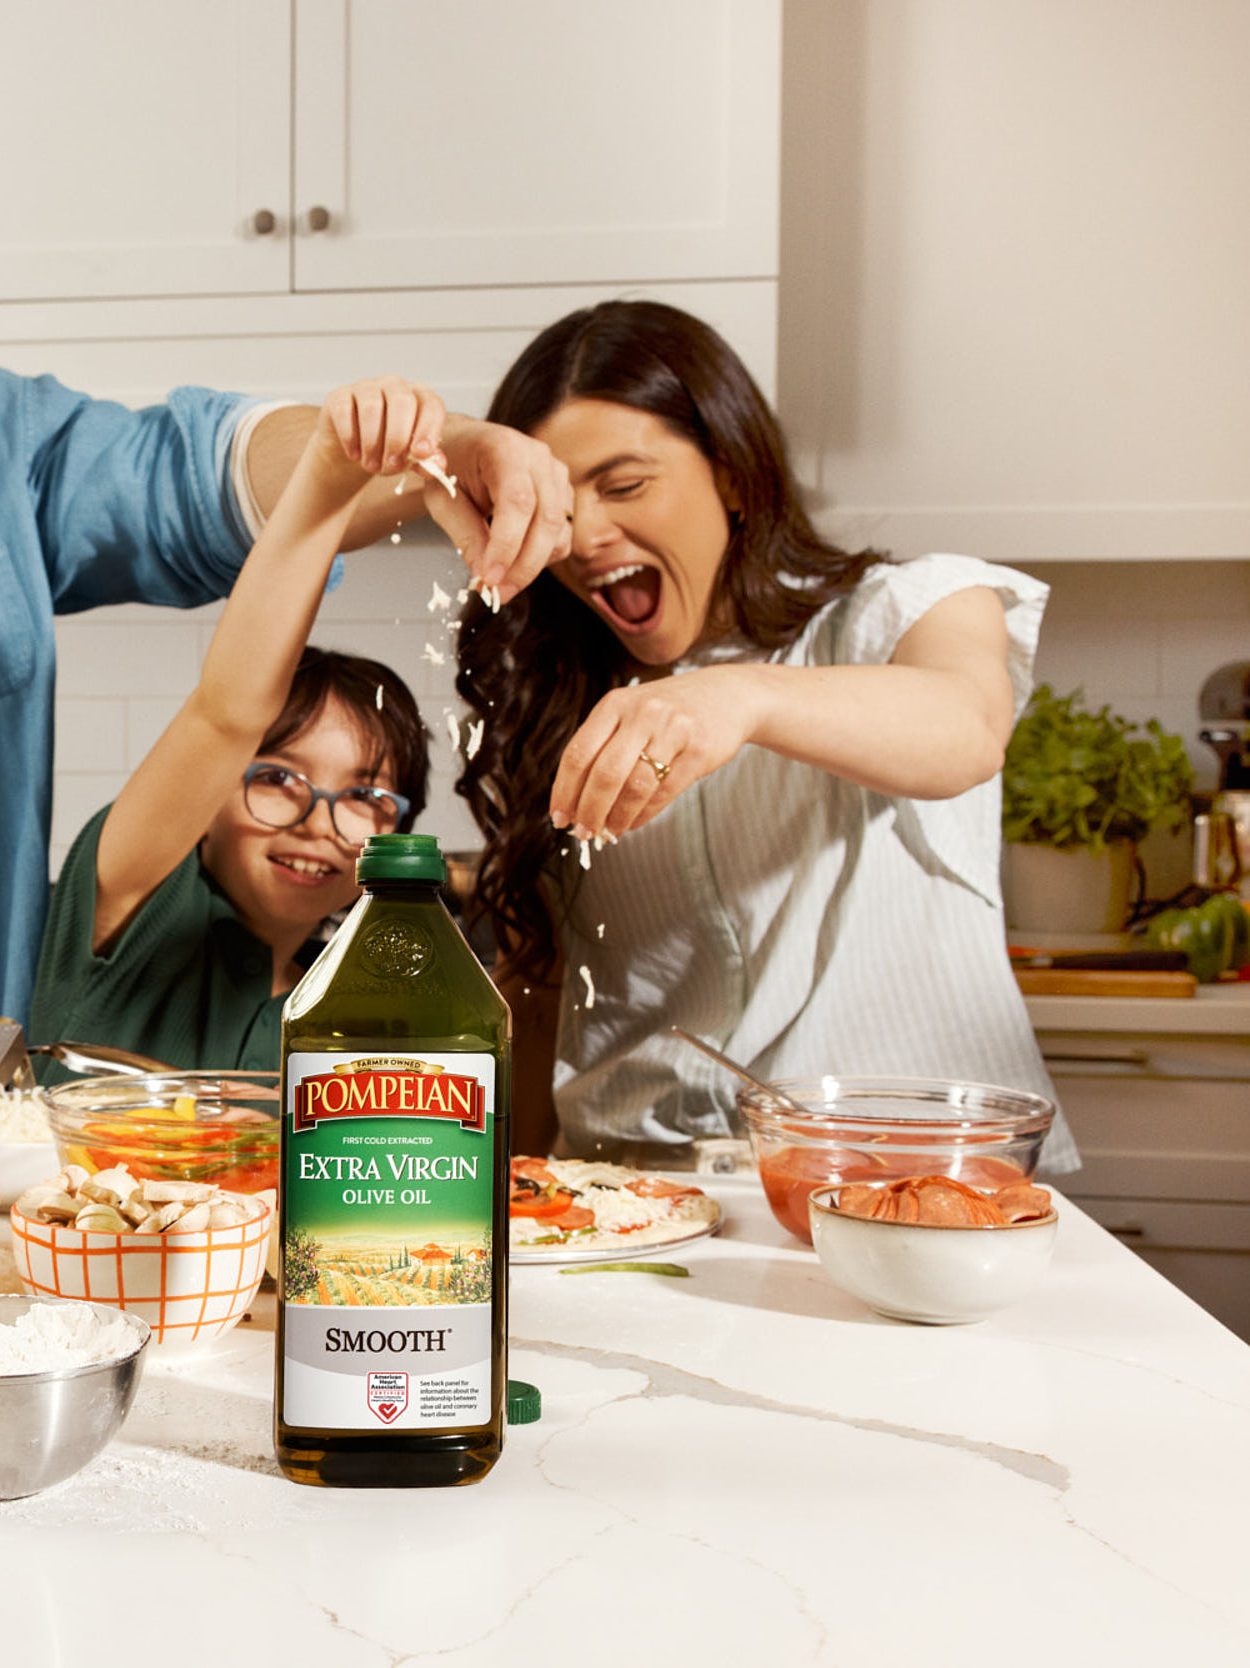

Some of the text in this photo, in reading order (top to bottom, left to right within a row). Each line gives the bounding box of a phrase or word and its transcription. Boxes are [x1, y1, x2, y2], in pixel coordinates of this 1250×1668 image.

[357, 1058, 421, 1068] FARMER OWNED
[306, 1075, 473, 1116] POMPEIAN
[342, 1136, 433, 1145] FIRST COLD EXTRACTED
[299, 1153, 479, 1181] EXTRA VIRGIN
[342, 1189, 432, 1205] OLIVE OIL
